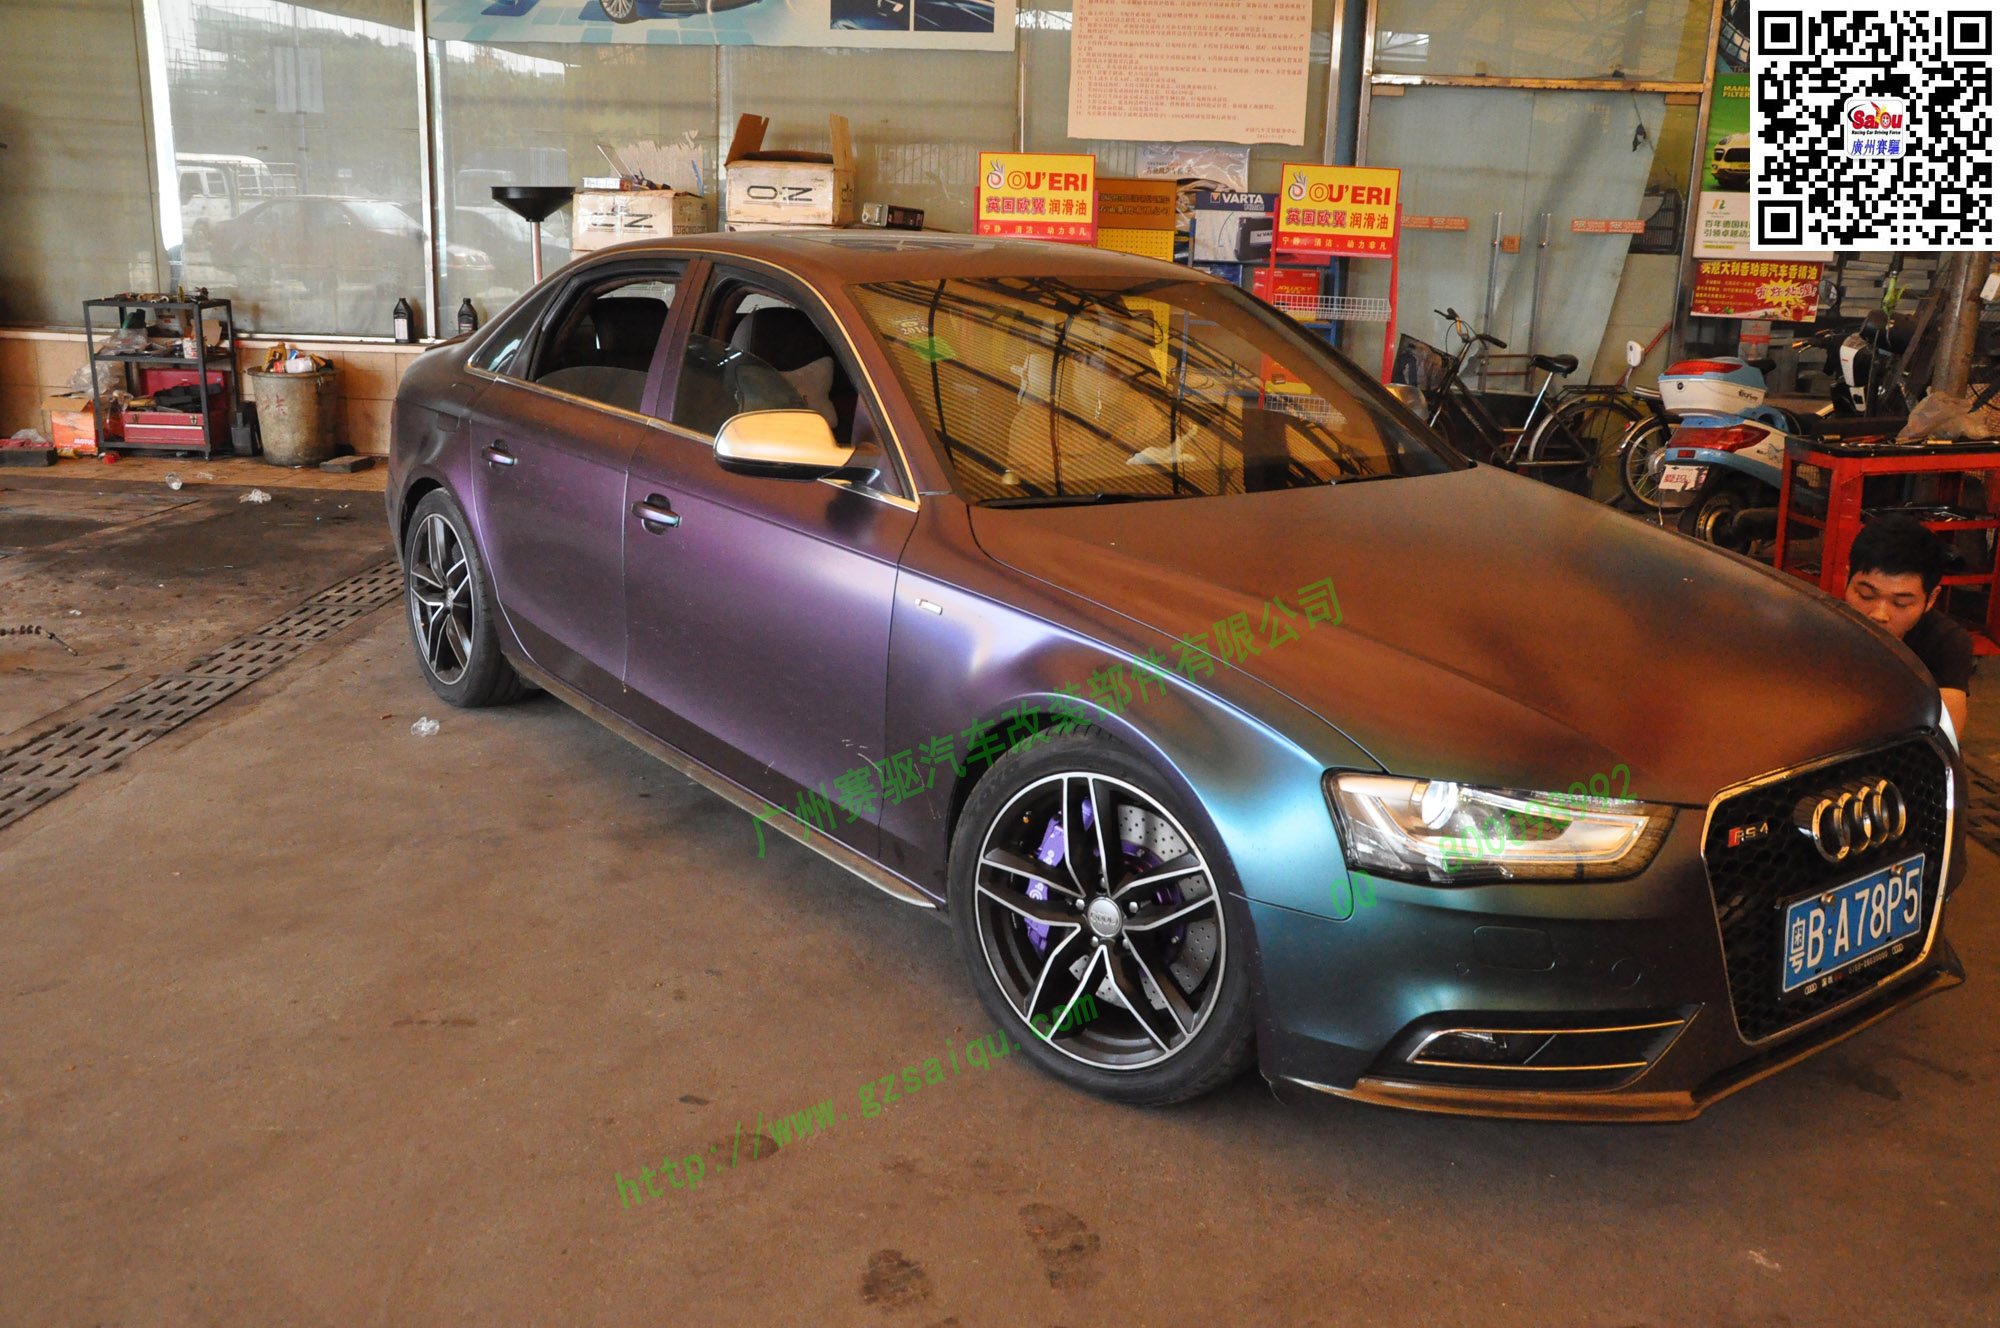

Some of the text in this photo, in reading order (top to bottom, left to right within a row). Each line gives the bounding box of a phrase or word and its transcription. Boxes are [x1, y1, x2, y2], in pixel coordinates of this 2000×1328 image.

[1222, 193, 1264, 204] VARTA
[1705, 220, 1750, 228] 百年德国科
